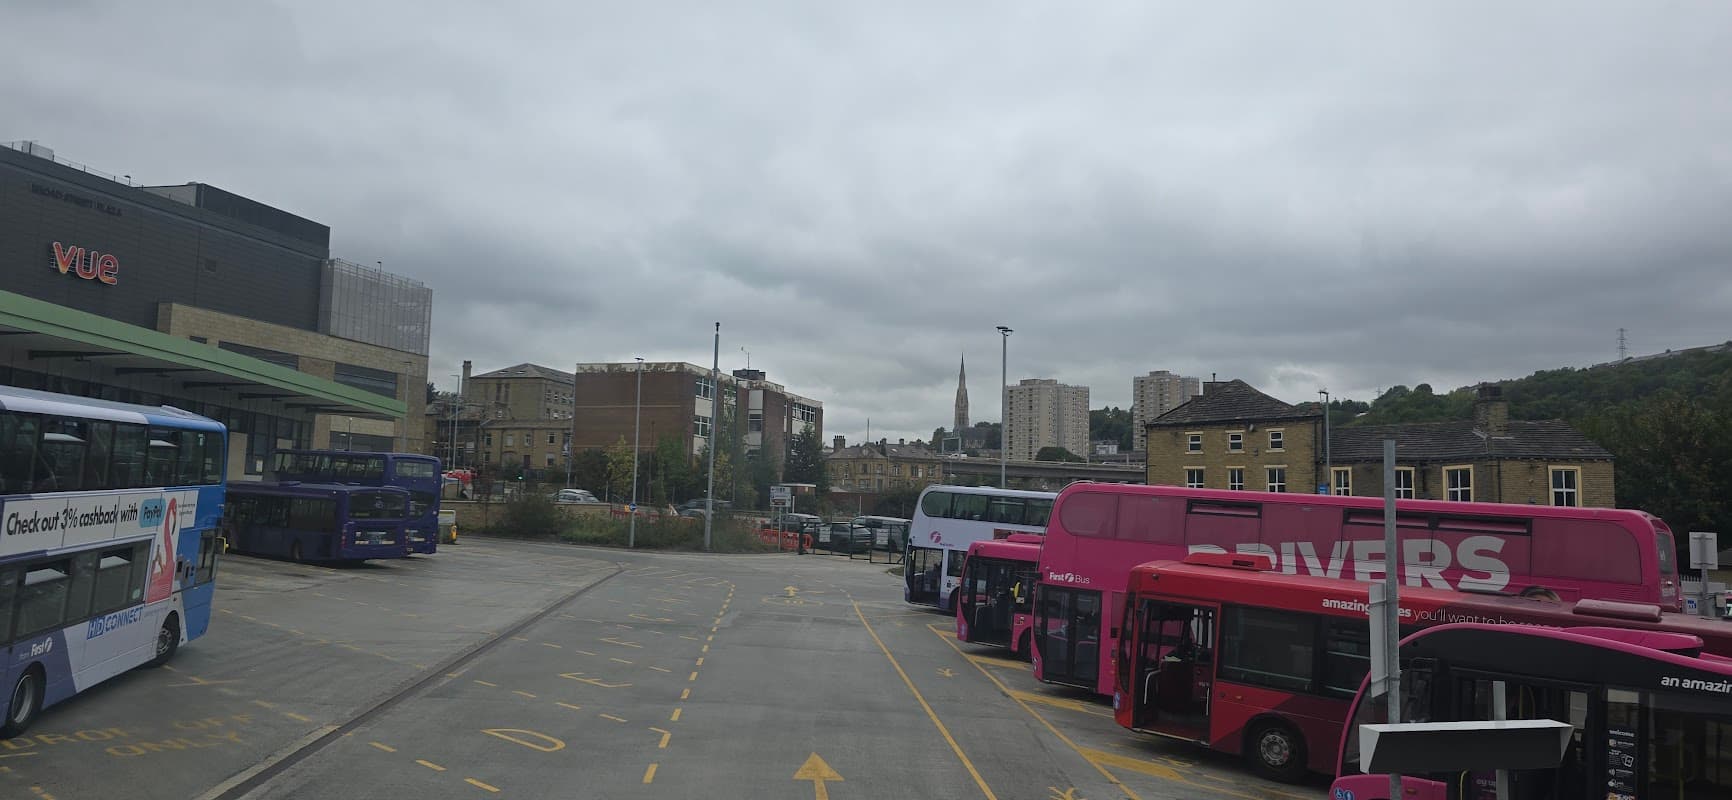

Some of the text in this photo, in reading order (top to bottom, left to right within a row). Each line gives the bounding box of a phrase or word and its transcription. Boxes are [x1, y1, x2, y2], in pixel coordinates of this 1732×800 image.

[7, 510, 40, 536] Check
[41, 512, 59, 532] out
[60, 508, 78, 530] 3%
[79, 504, 118, 527] cashback
[120, 502, 138, 522] with
[1188, 535, 1510, 593] IVERS
[1050, 572, 1090, 584] First Bus
[104, 606, 144, 632] CONNECT
[1413, 608, 1446, 621] you'll
[1448, 613, 1479, 624] want
[1482, 616, 1496, 625] to
[31, 641, 45, 657] First
[1660, 676, 1680, 688] an
